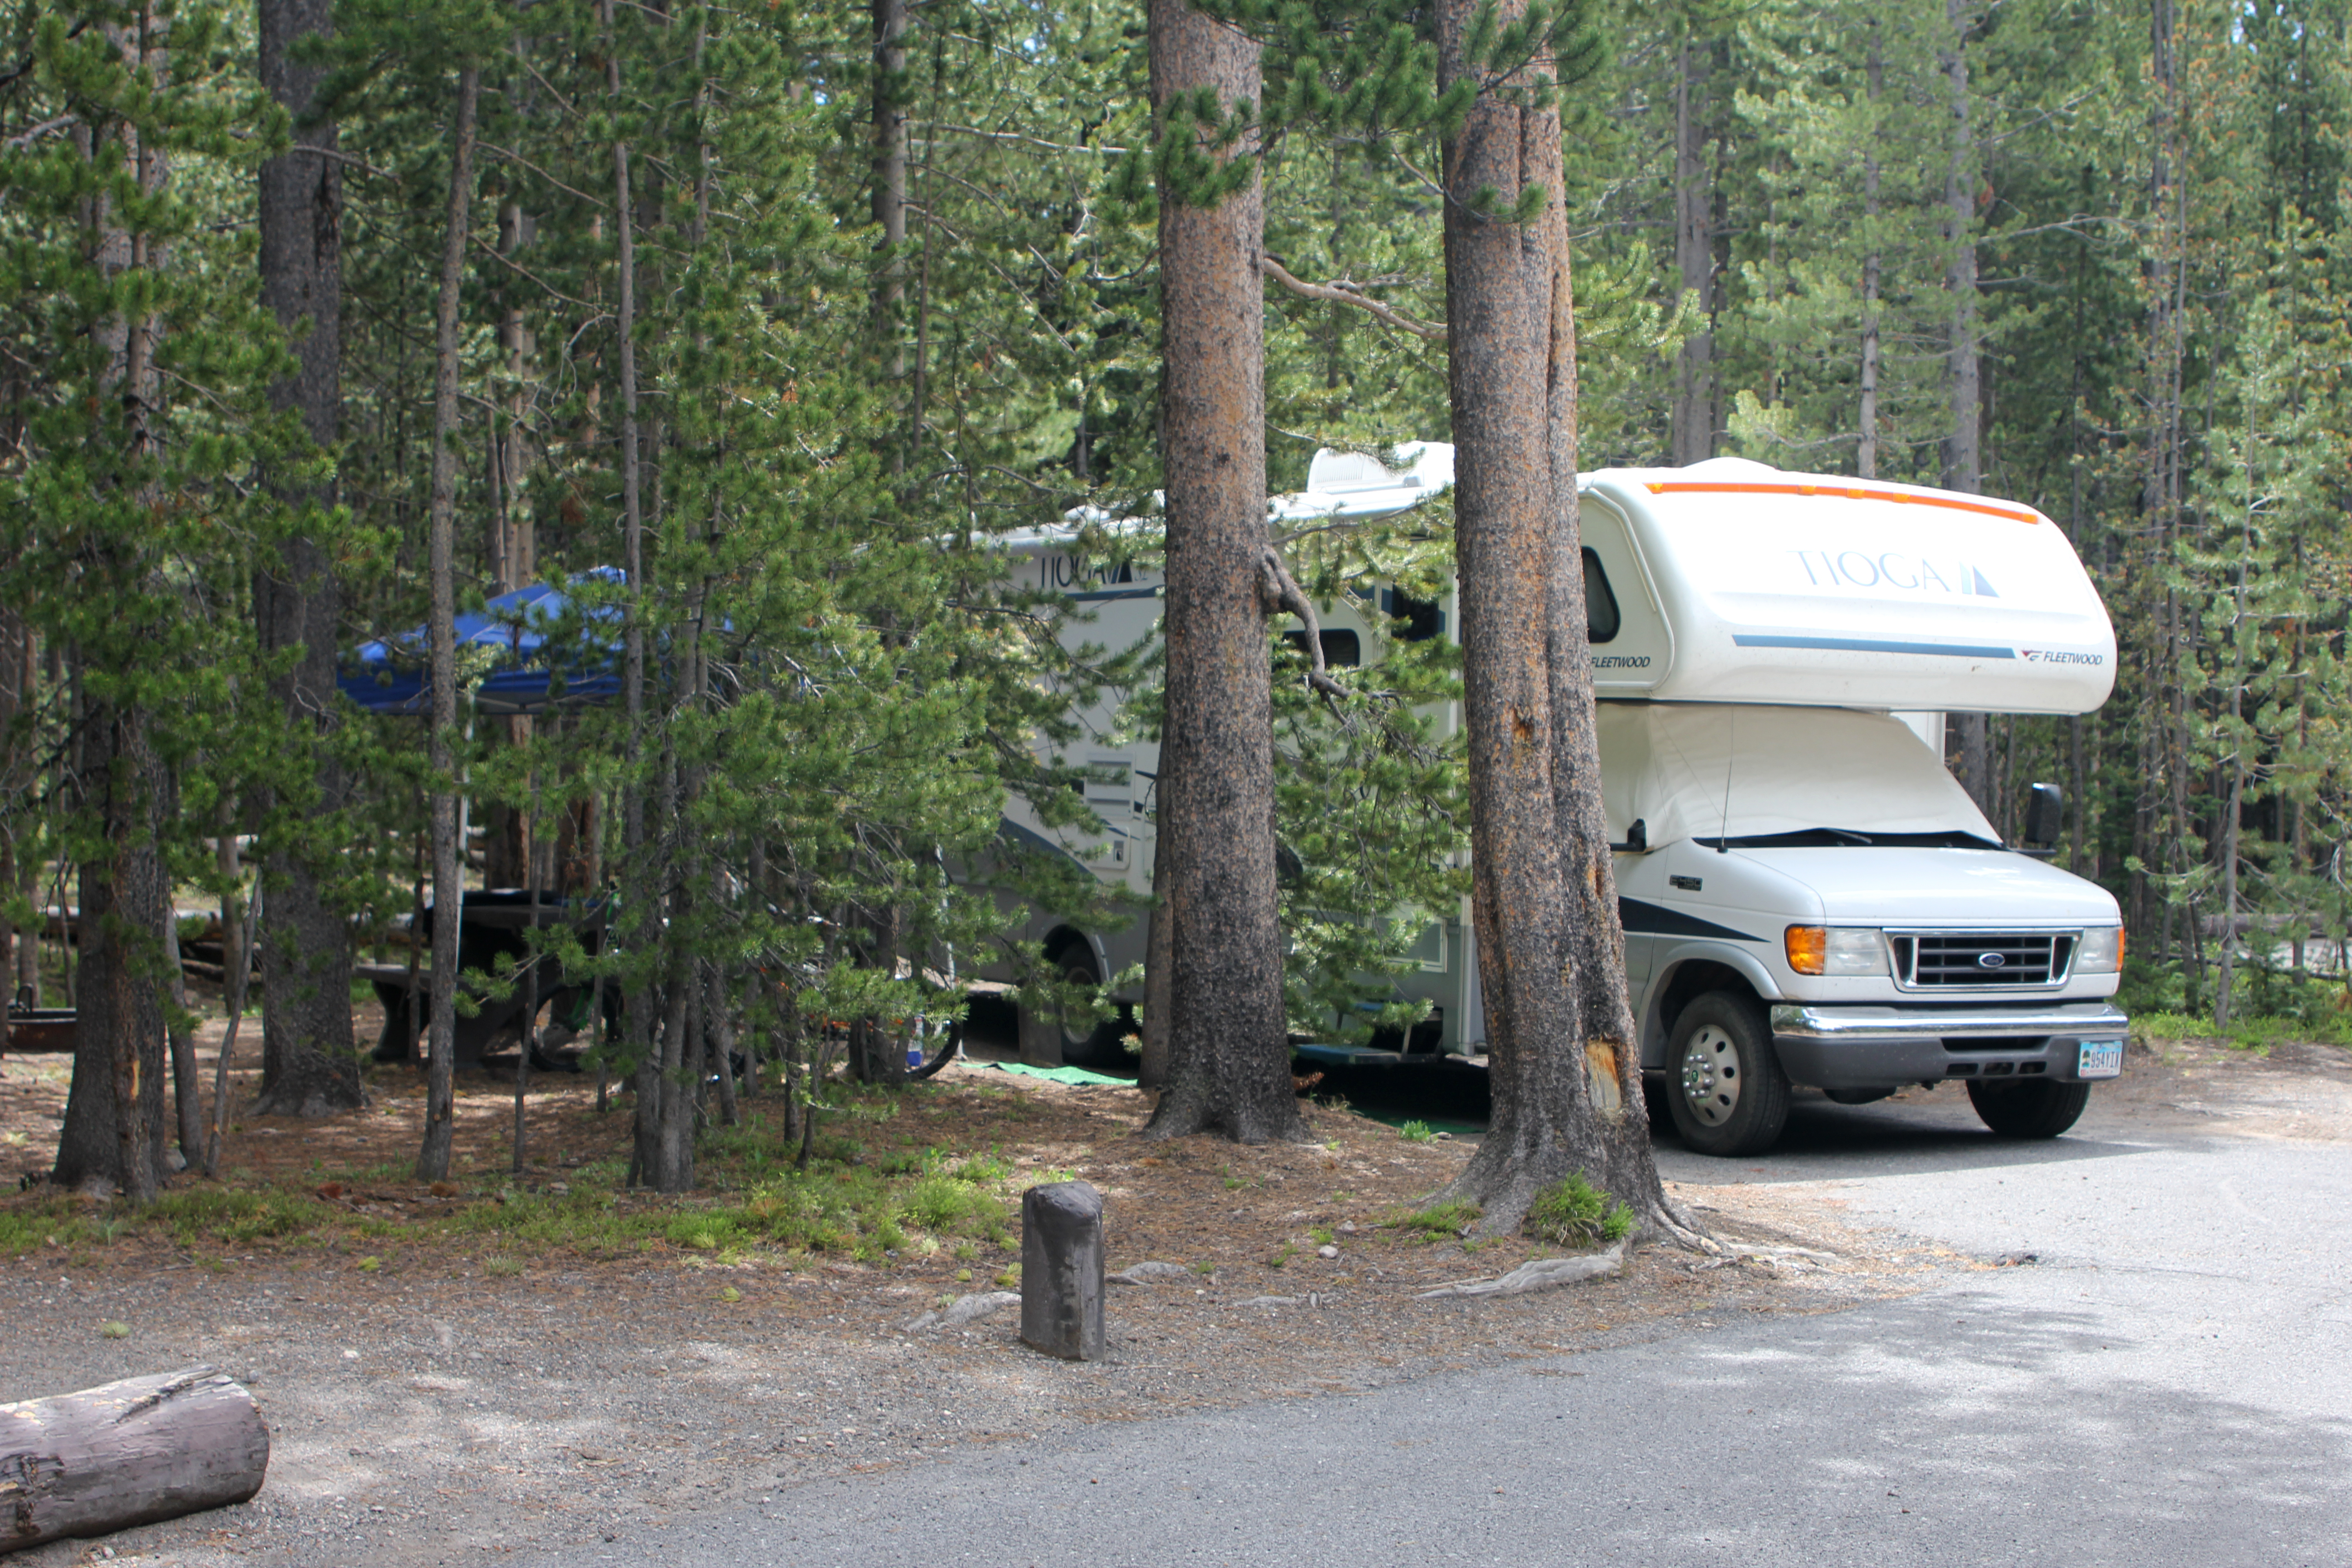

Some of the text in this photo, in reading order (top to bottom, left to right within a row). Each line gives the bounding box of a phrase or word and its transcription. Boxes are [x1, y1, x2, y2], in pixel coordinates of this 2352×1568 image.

[1786, 550, 1951, 592] TIOGA
[1591, 656, 1651, 668] FLEETWOOD
[2044, 651, 2102, 665] FLEETWOOD
[2091, 1051, 2120, 1068] 954YIX
